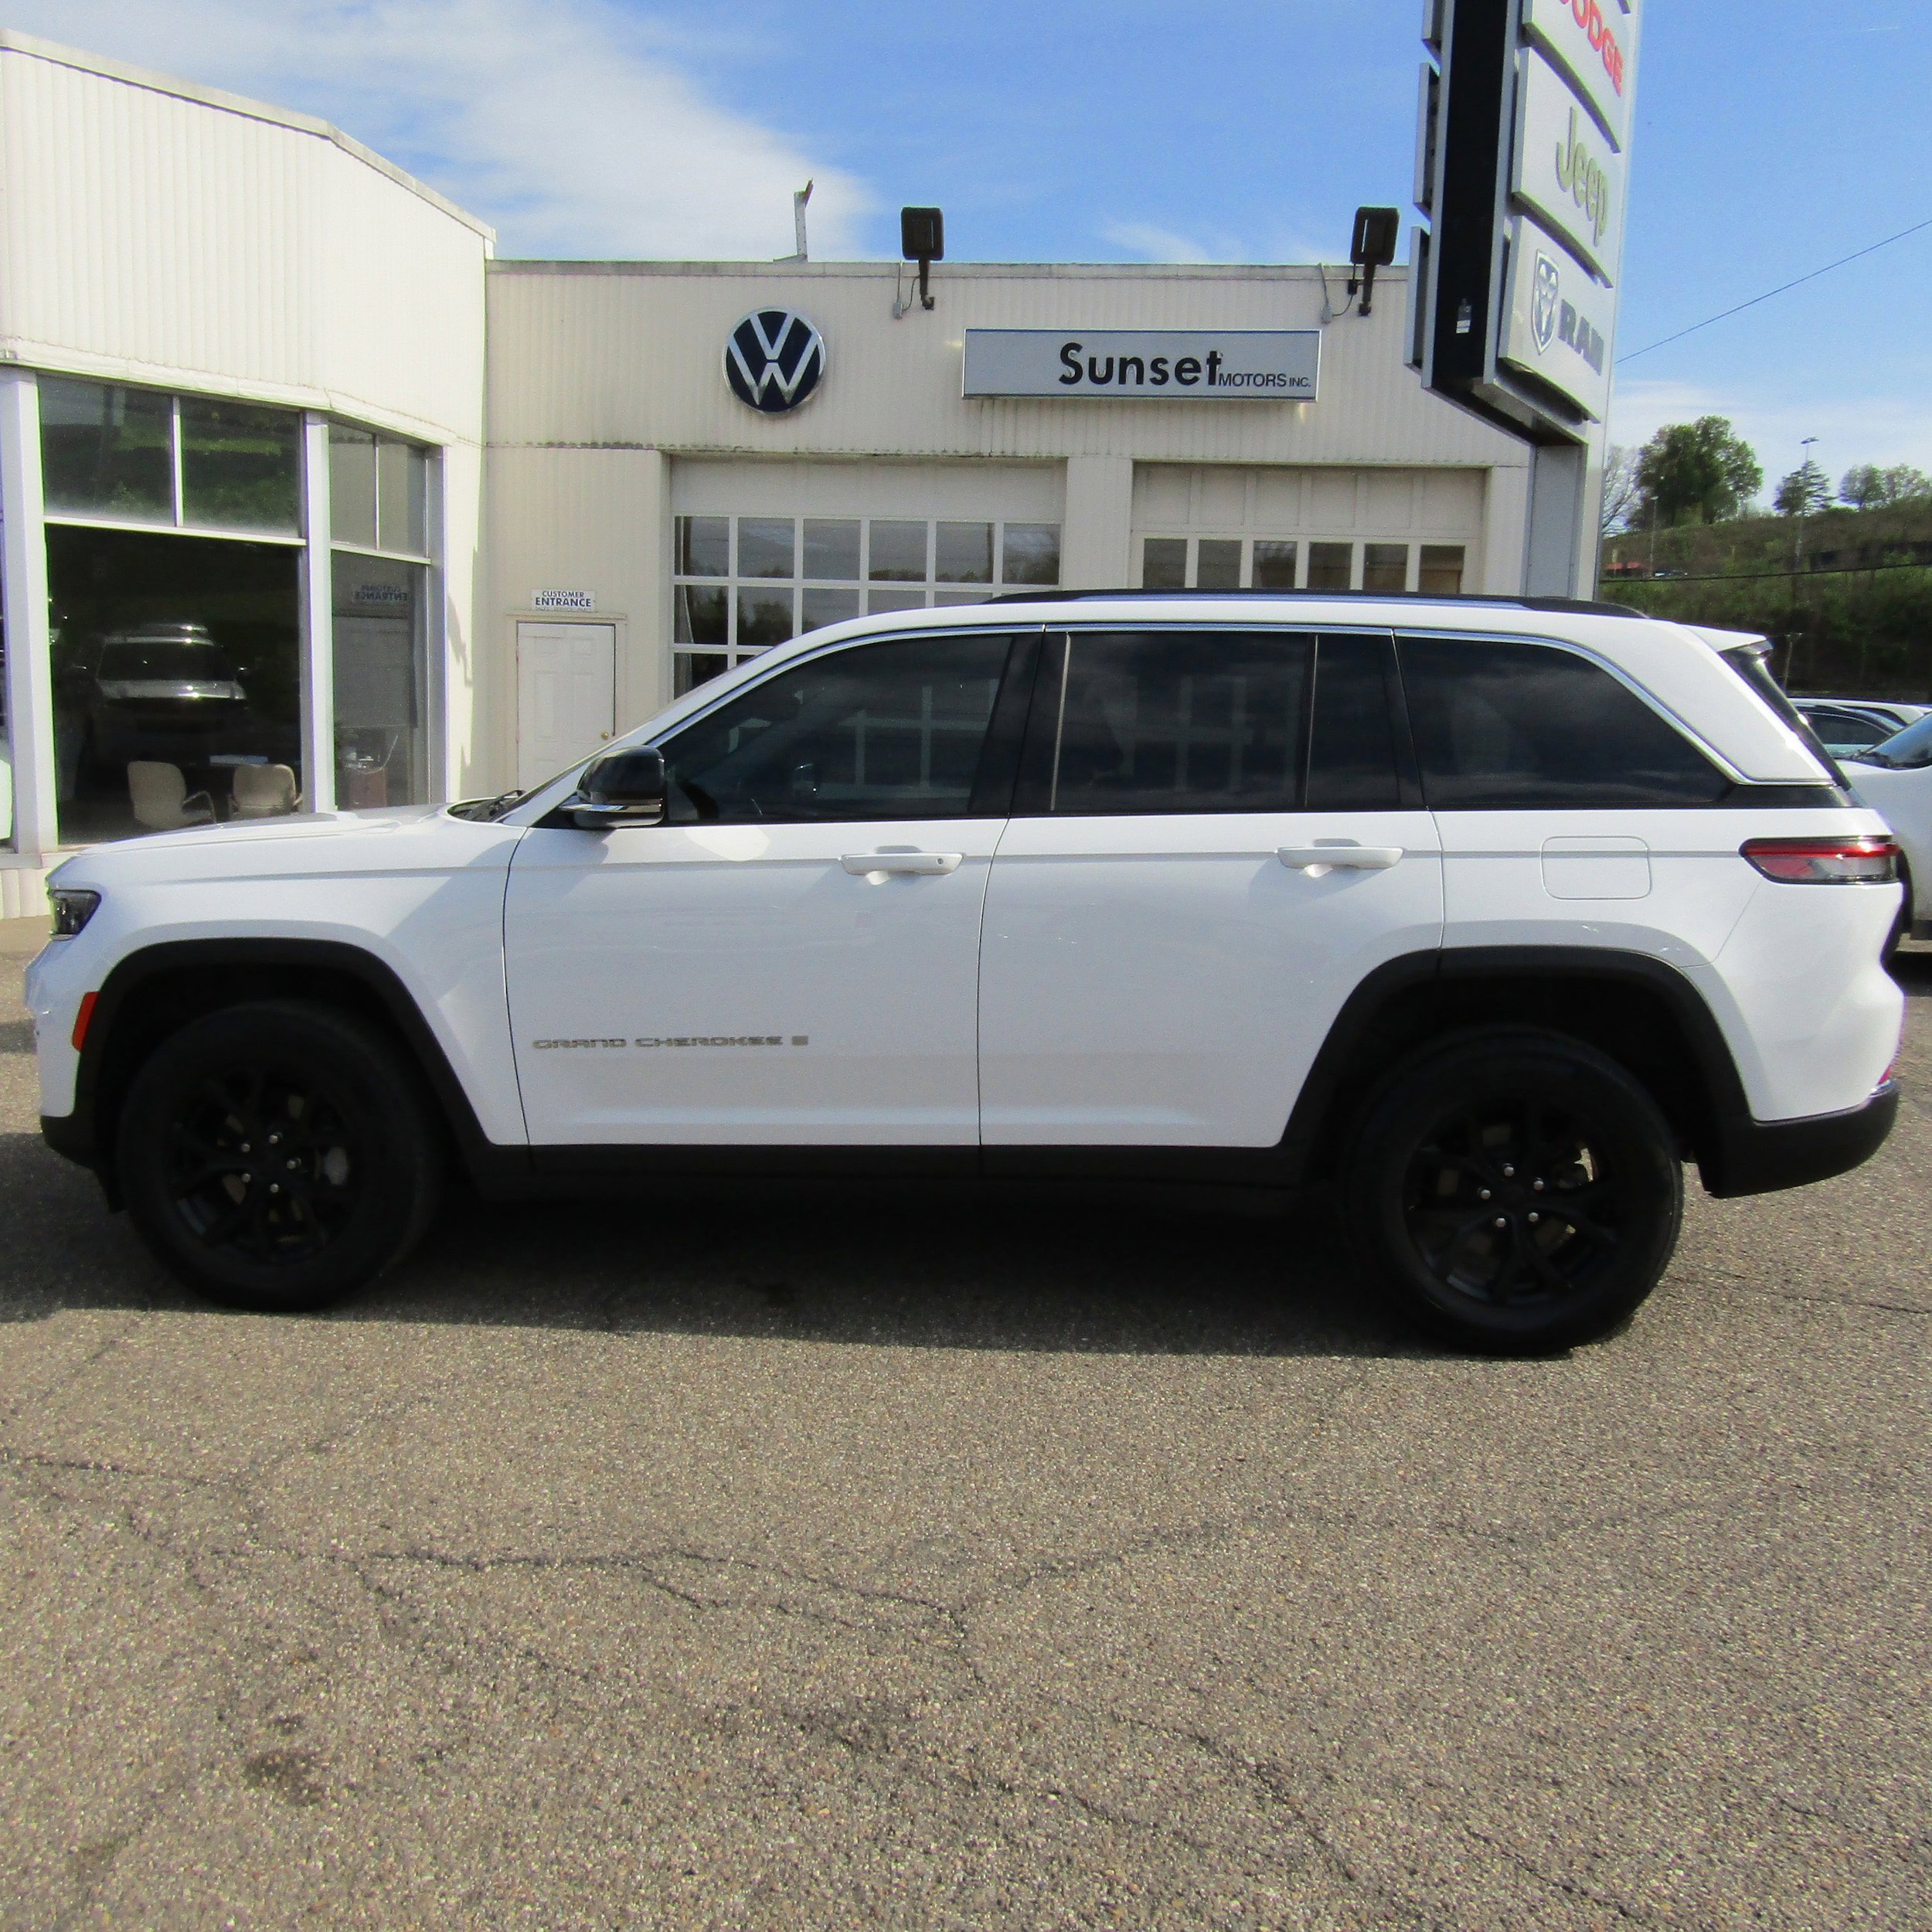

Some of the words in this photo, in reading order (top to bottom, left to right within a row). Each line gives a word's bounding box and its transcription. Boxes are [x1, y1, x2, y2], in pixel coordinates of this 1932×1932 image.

[1560, 0, 1623, 97] ODGE
[1556, 106, 1608, 247] Jeep
[723, 308, 822, 409] VW
[1059, 342, 1222, 386] Sunset
[1219, 372, 1287, 387] MOTORS
[1289, 377, 1311, 387] INC.
[1558, 299, 1604, 376] RAM
[535, 597, 592, 607] ENTRANCE
[532, 1038, 627, 1049] GRAND
[635, 1036, 784, 1047] CHEROKEE
